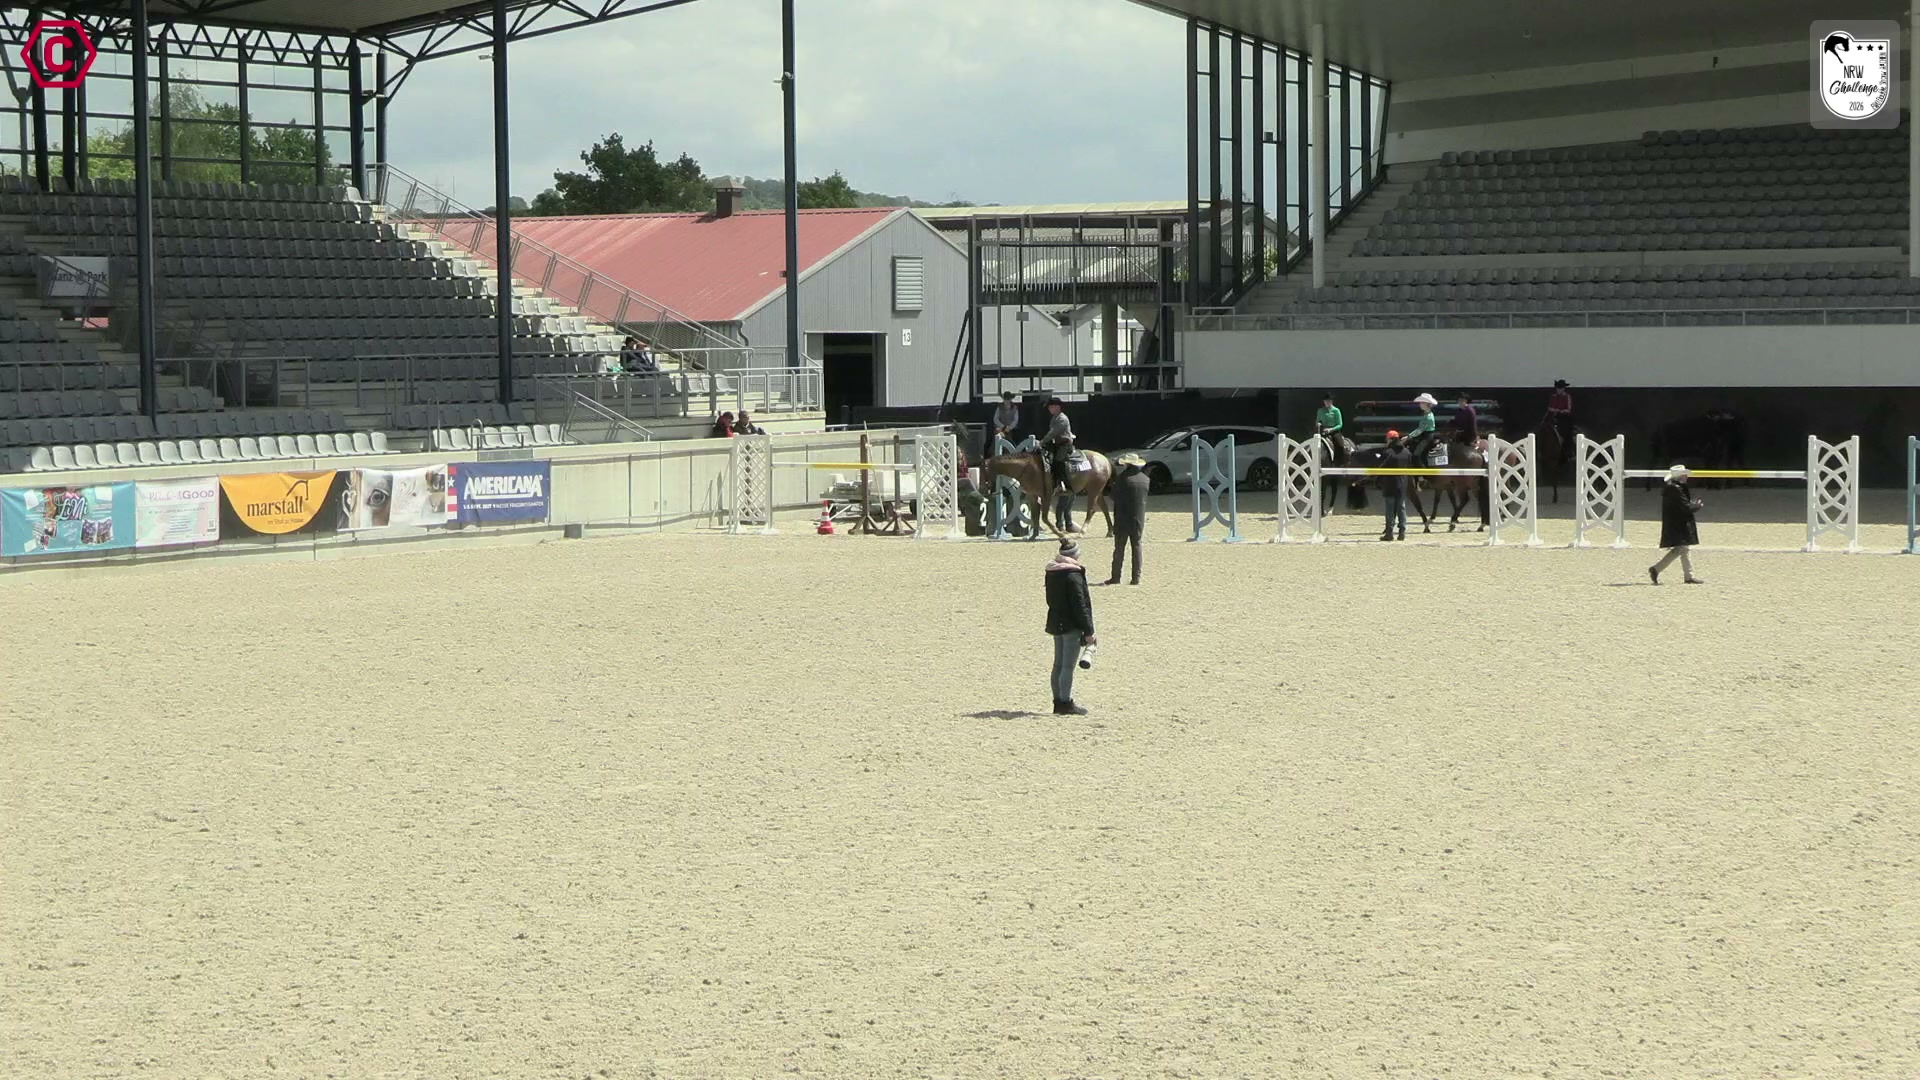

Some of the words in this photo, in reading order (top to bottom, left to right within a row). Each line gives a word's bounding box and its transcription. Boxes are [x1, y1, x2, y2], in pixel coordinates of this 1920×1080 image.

[903, 332, 911, 342] 13
[464, 474, 543, 500] AMERICANA
[247, 496, 303, 517] marstall
[980, 502, 987, 527] 2
